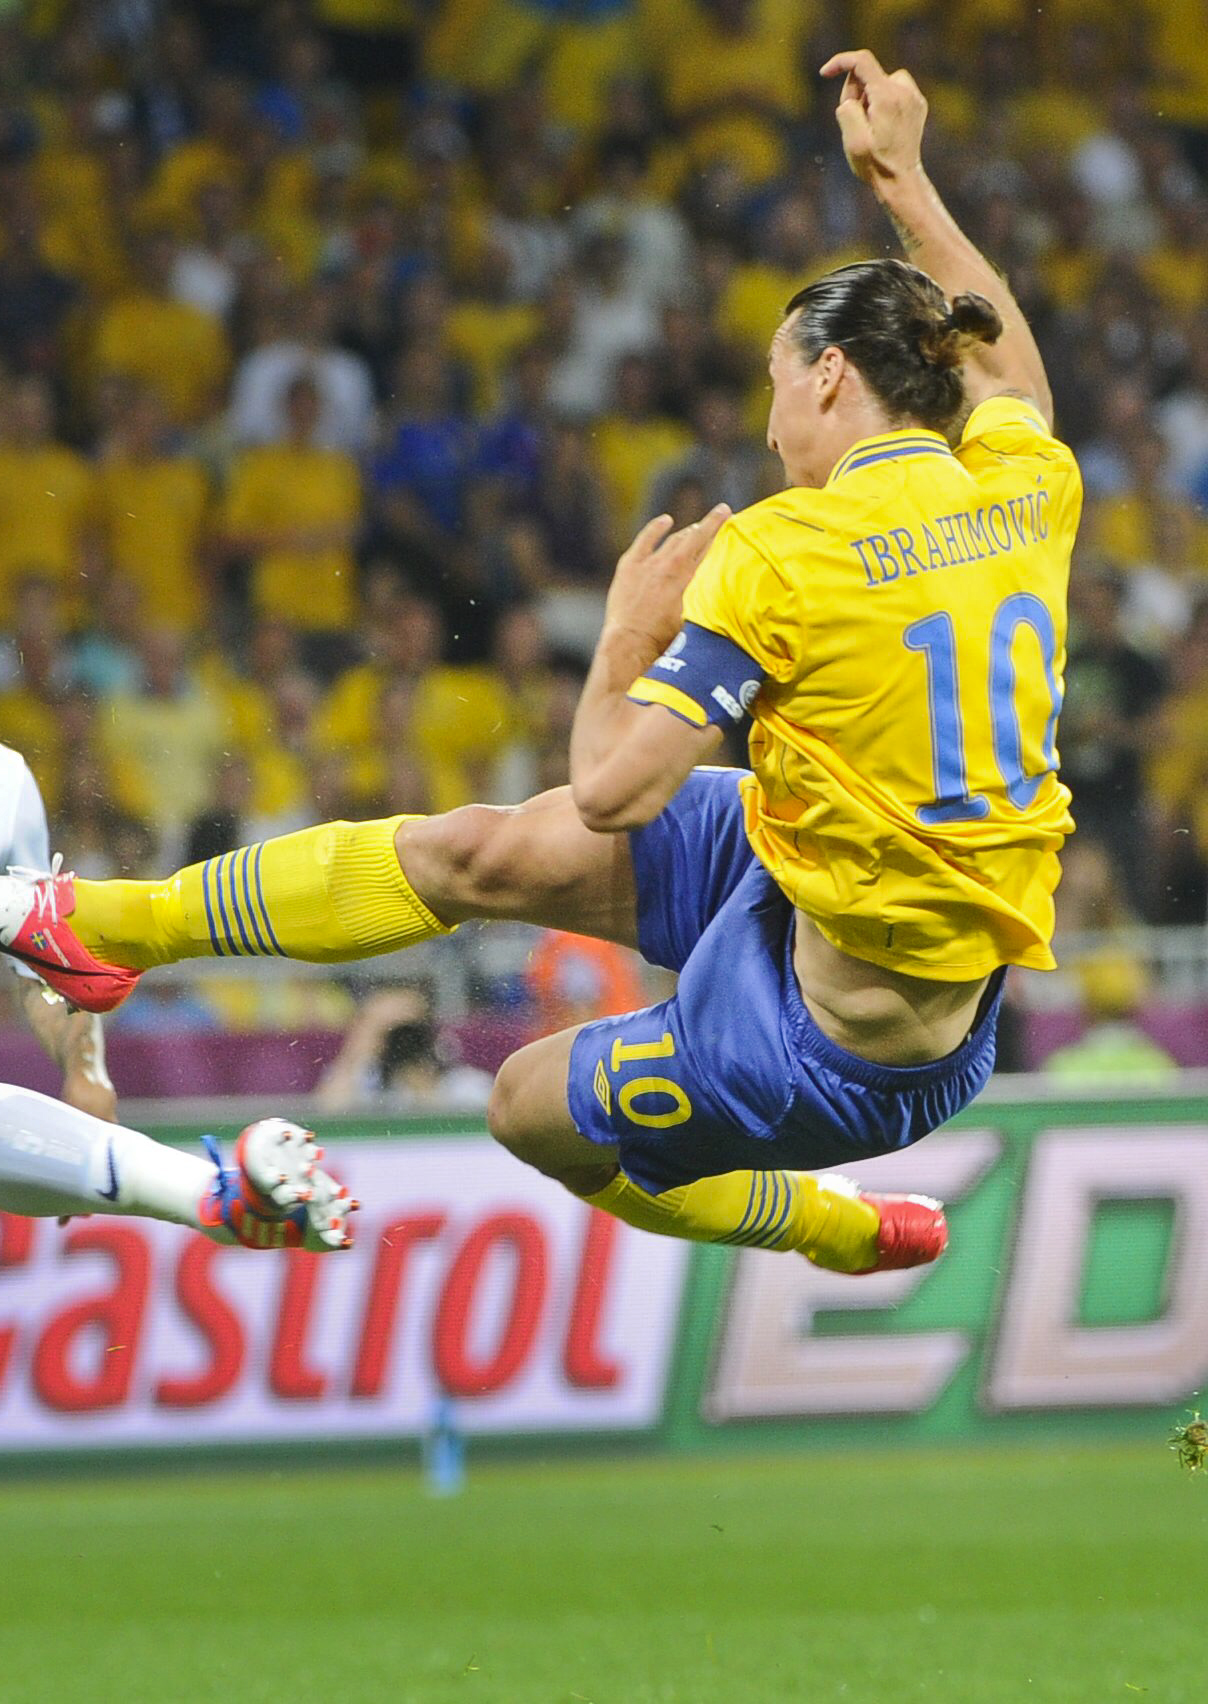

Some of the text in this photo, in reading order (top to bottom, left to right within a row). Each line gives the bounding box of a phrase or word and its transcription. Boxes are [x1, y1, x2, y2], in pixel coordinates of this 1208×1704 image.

[850, 475, 1049, 587] IBRAHIMOVIĆ
[903, 591, 1063, 824] 10
[611, 1031, 692, 1129] 10
